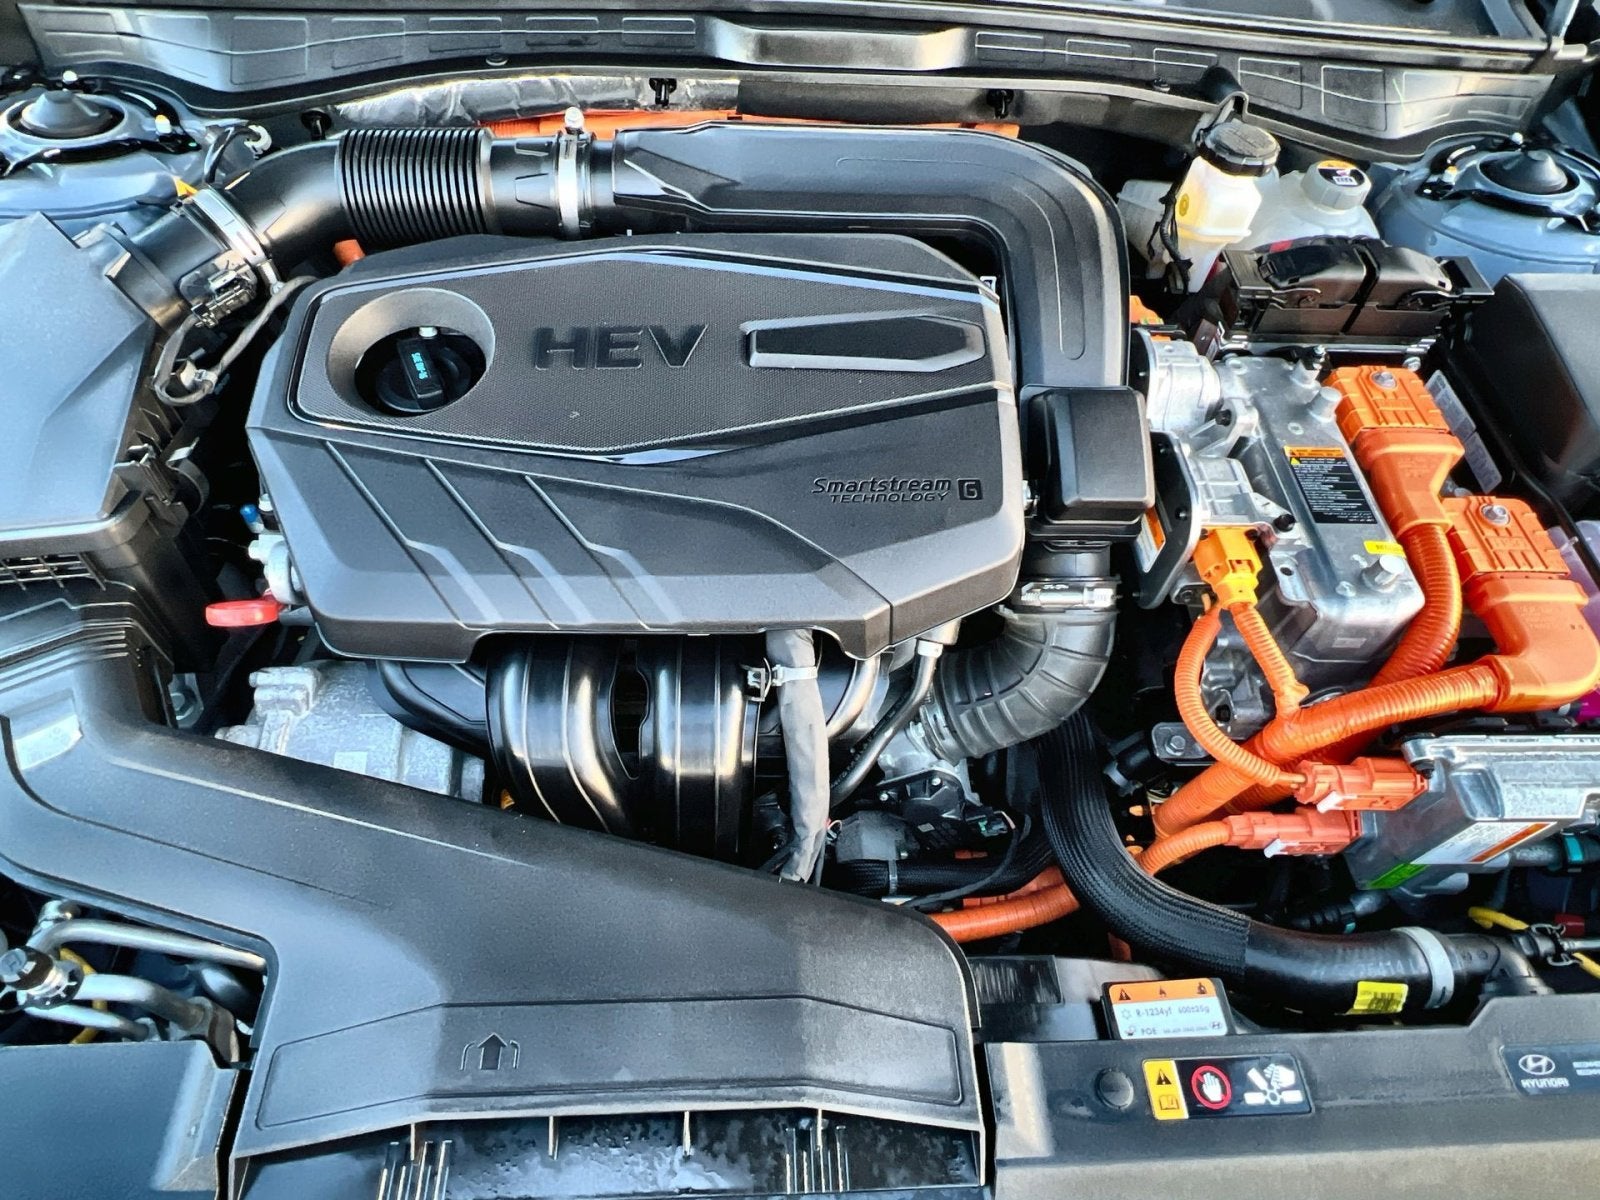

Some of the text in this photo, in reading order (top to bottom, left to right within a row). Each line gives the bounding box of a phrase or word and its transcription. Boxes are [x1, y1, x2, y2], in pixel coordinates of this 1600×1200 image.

[534, 323, 709, 371] HEV
[812, 476, 980, 499] Smartstream G
[829, 492, 949, 503] TECHNOLOGY
[1520, 1077, 1570, 1088] HYUNDAI
